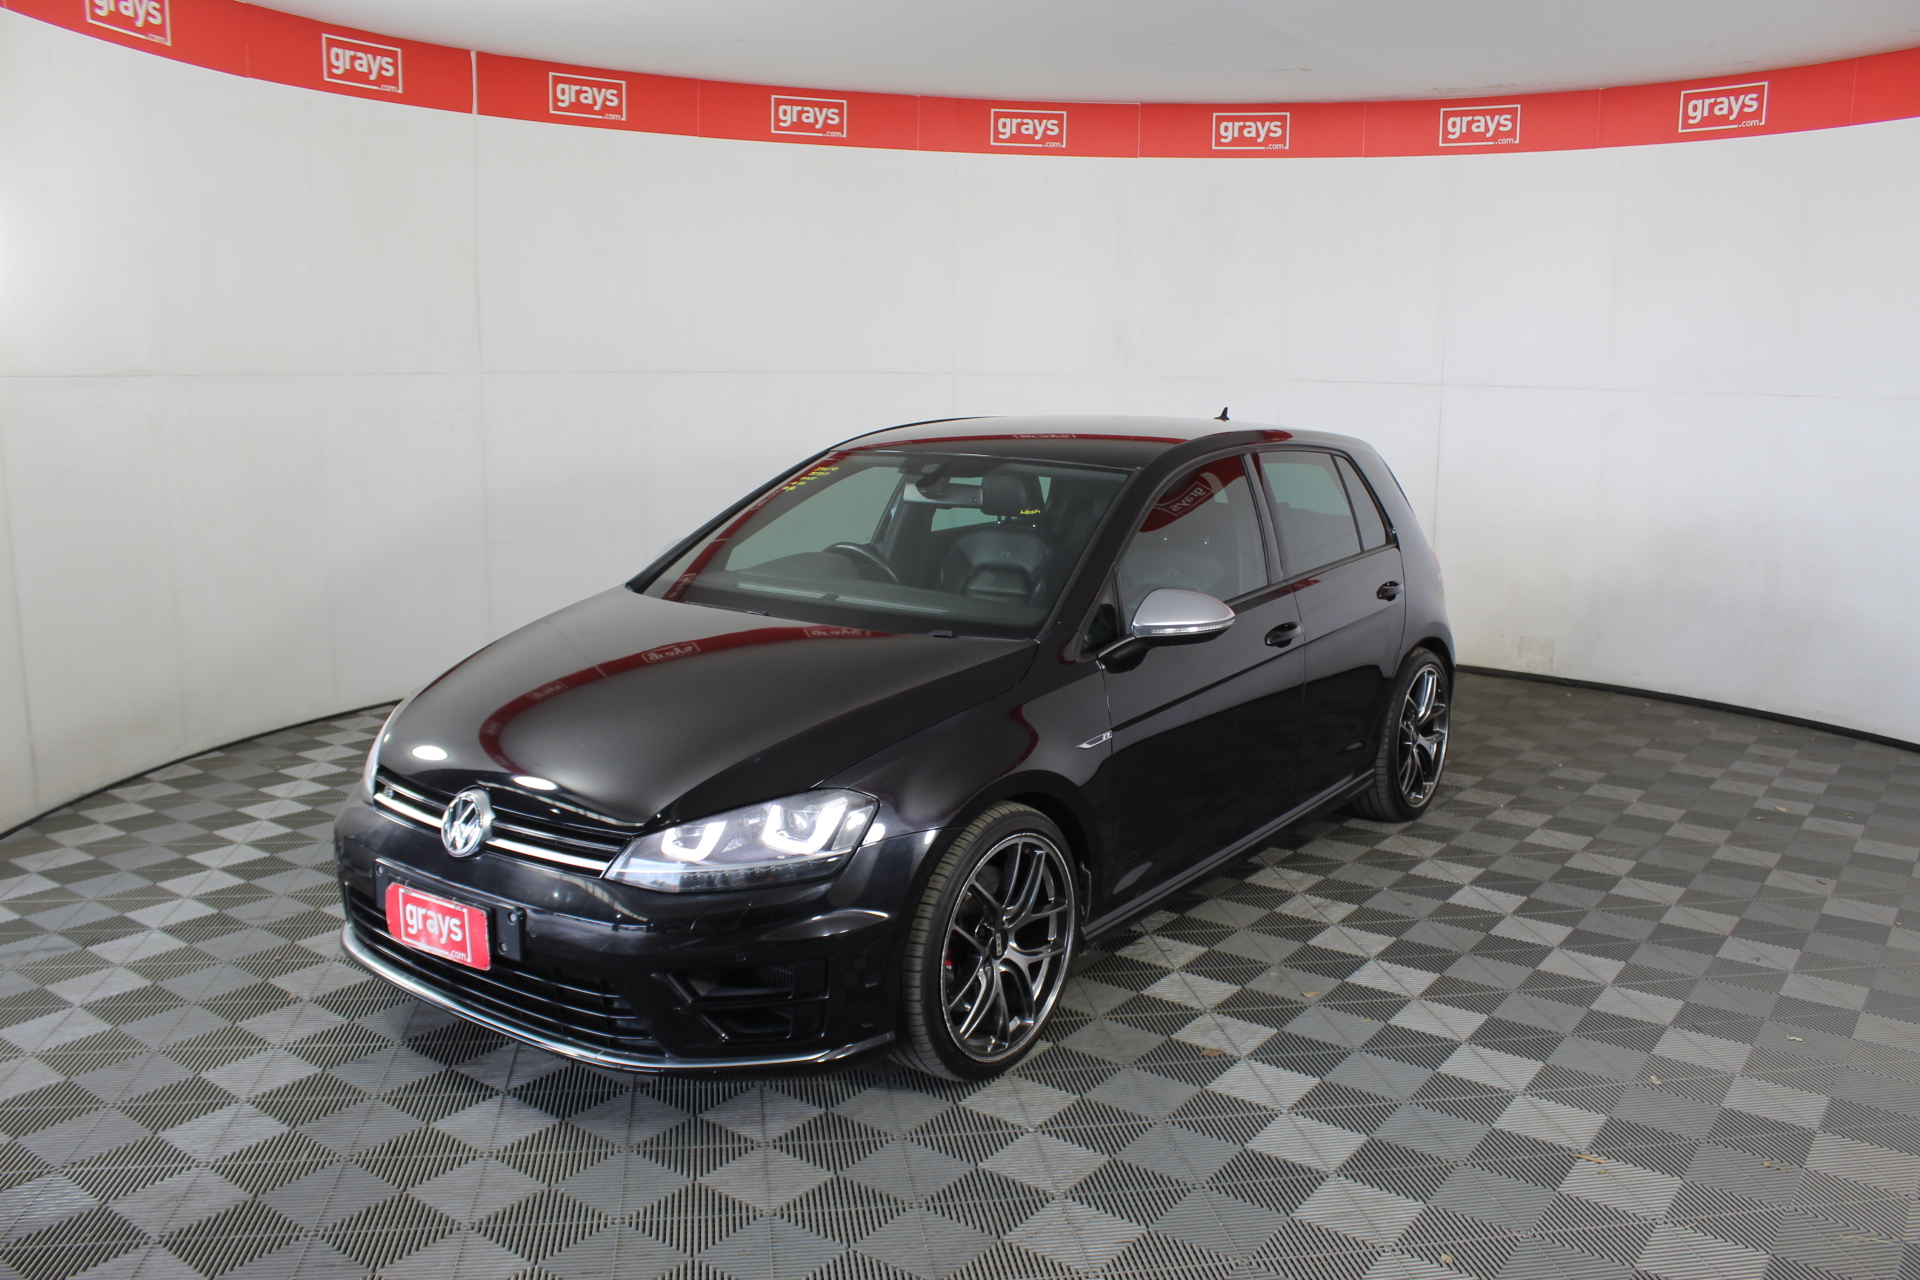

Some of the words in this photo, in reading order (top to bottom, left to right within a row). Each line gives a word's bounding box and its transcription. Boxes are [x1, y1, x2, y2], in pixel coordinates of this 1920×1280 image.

[330, 47, 395, 80] grays
[378, 84, 397, 93] .com
[556, 83, 619, 111] grays
[602, 113, 621, 121] .com
[778, 105, 840, 129] grays
[1687, 93, 1759, 125] grays
[998, 118, 1060, 140] grays
[1219, 121, 1283, 143] grays
[1447, 114, 1513, 140] grays
[1738, 119, 1760, 128] .com
[1495, 137, 1514, 145] .com
[405, 903, 464, 945] grays
[449, 950, 468, 962] .com
